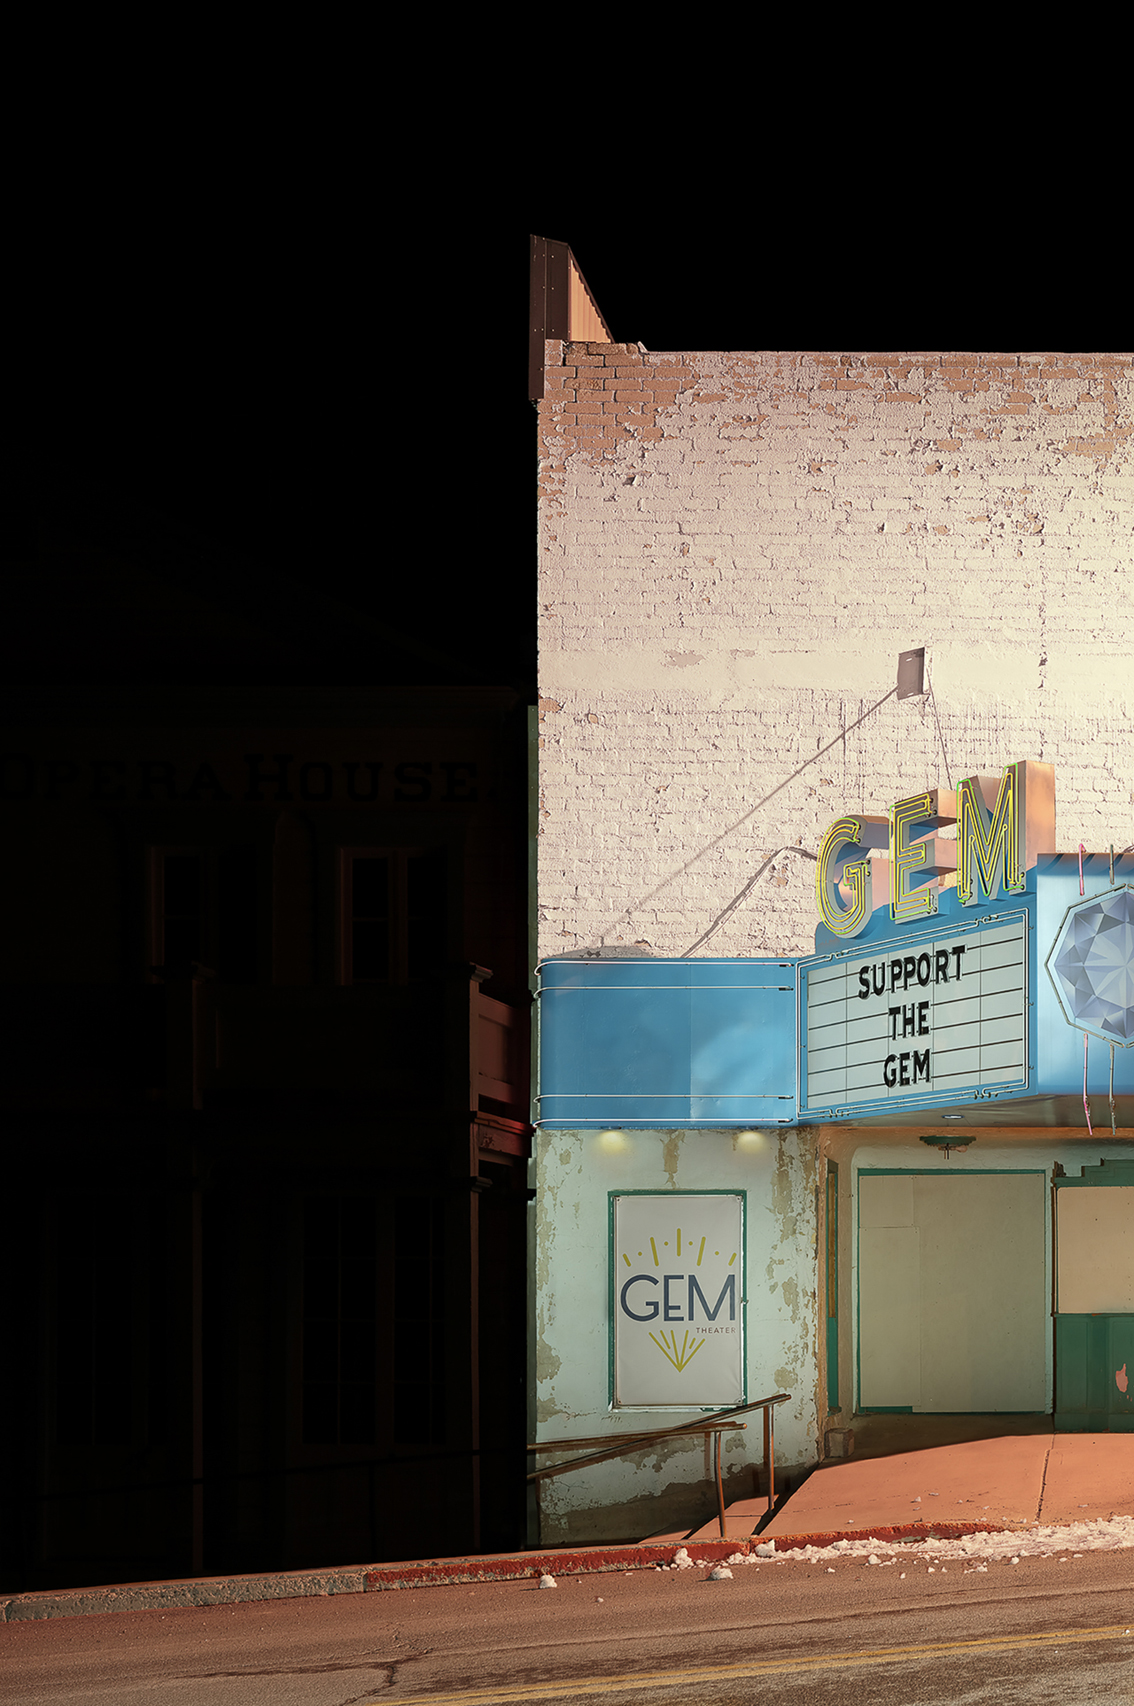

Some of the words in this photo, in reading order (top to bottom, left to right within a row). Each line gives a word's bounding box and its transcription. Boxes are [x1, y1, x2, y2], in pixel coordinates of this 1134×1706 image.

[0, 752, 232, 800] OPERA
[243, 753, 478, 802] HOUSE
[816, 762, 1028, 938] GEM
[858, 944, 966, 1000] SUPPORT
[888, 1000, 930, 1041] THE
[883, 1048, 931, 1088] GEM
[620, 1274, 736, 1322] GEM
